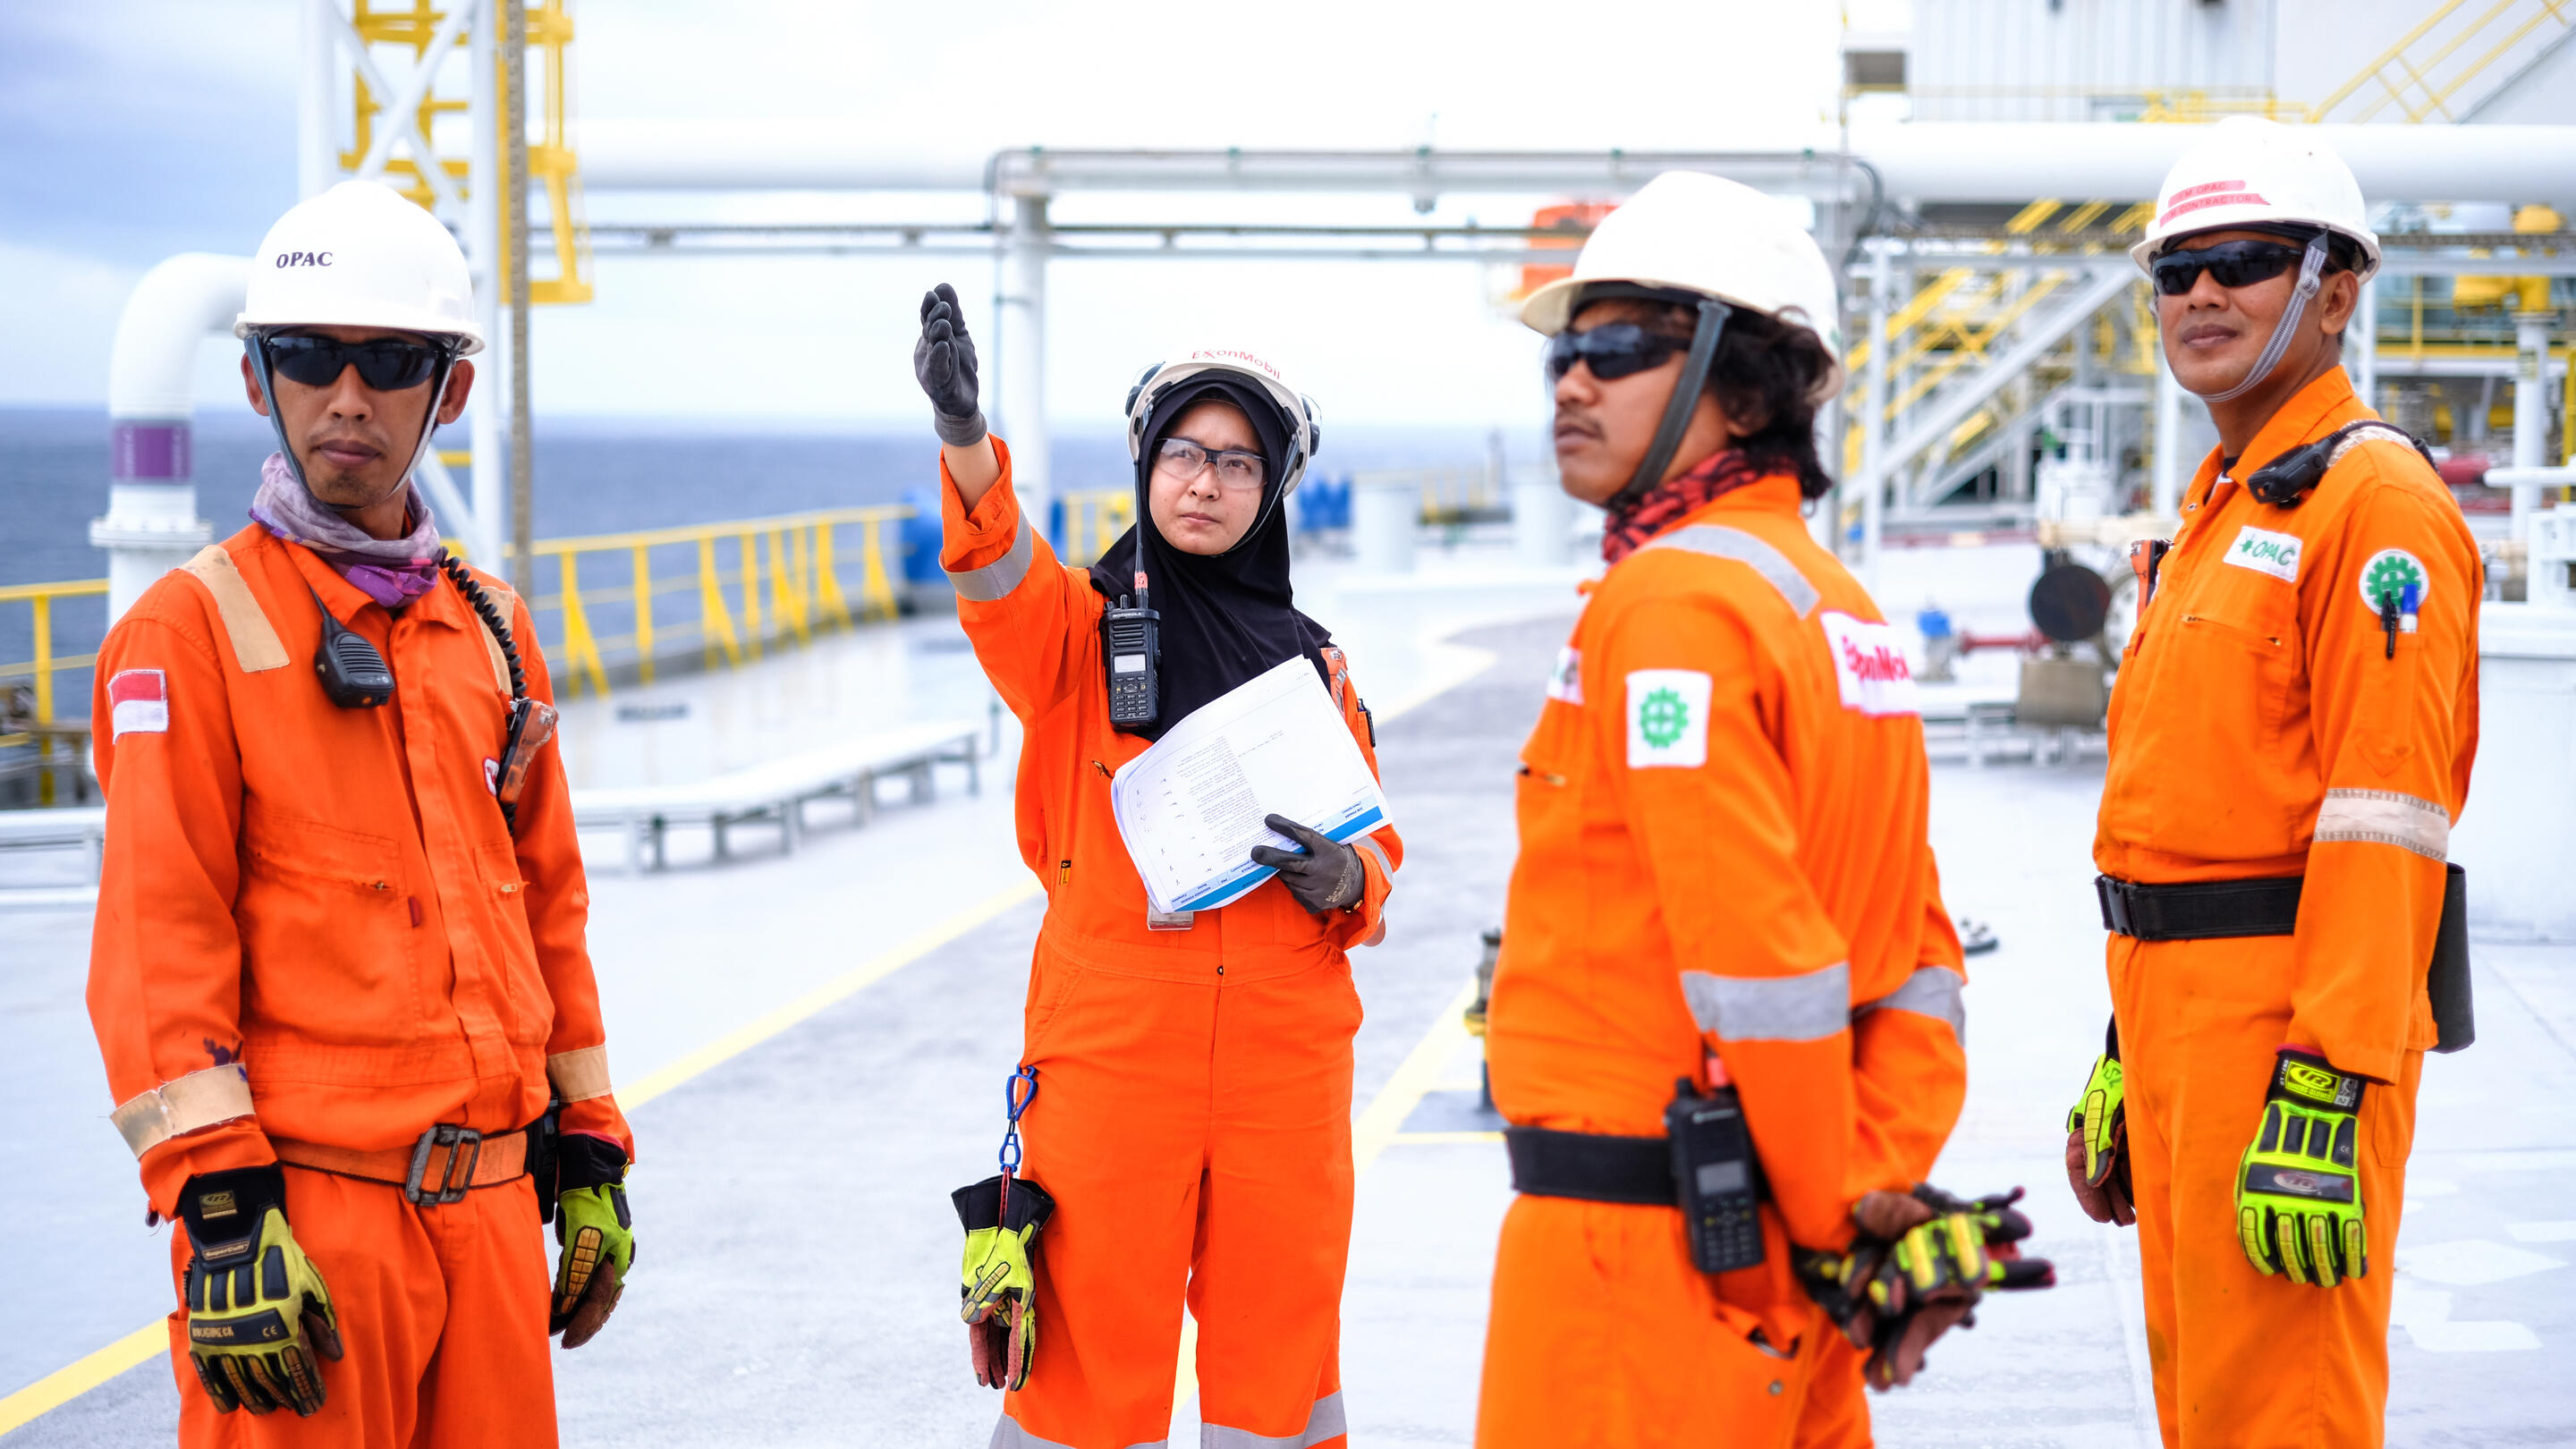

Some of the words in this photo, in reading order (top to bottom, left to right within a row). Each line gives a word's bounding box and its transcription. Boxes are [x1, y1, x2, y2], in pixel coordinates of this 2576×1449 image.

[2197, 182, 2226, 194] OPAC
[2179, 193, 2252, 214] CONTRACTOR
[275, 251, 334, 269] OPAC
[1191, 350, 1280, 380] ExxonMobil
[2251, 540, 2296, 566] OPAC
